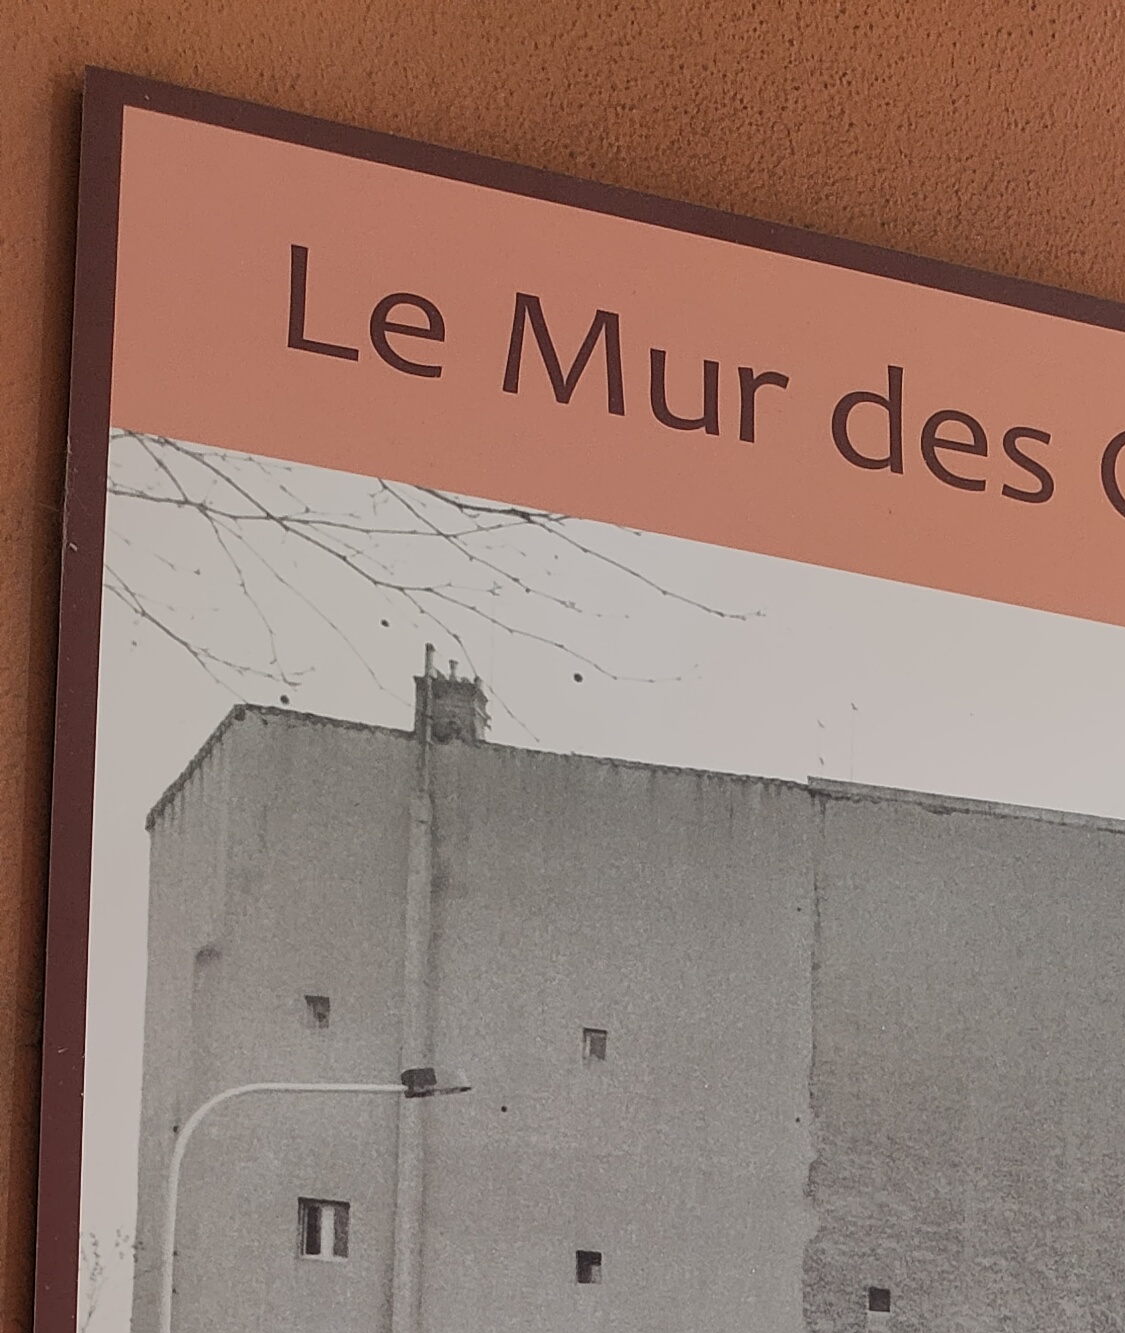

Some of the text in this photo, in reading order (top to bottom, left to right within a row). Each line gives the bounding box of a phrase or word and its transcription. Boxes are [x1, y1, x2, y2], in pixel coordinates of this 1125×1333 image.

[287, 243, 446, 378] Le
[502, 291, 790, 444] Mur
[831, 364, 1055, 504] des
